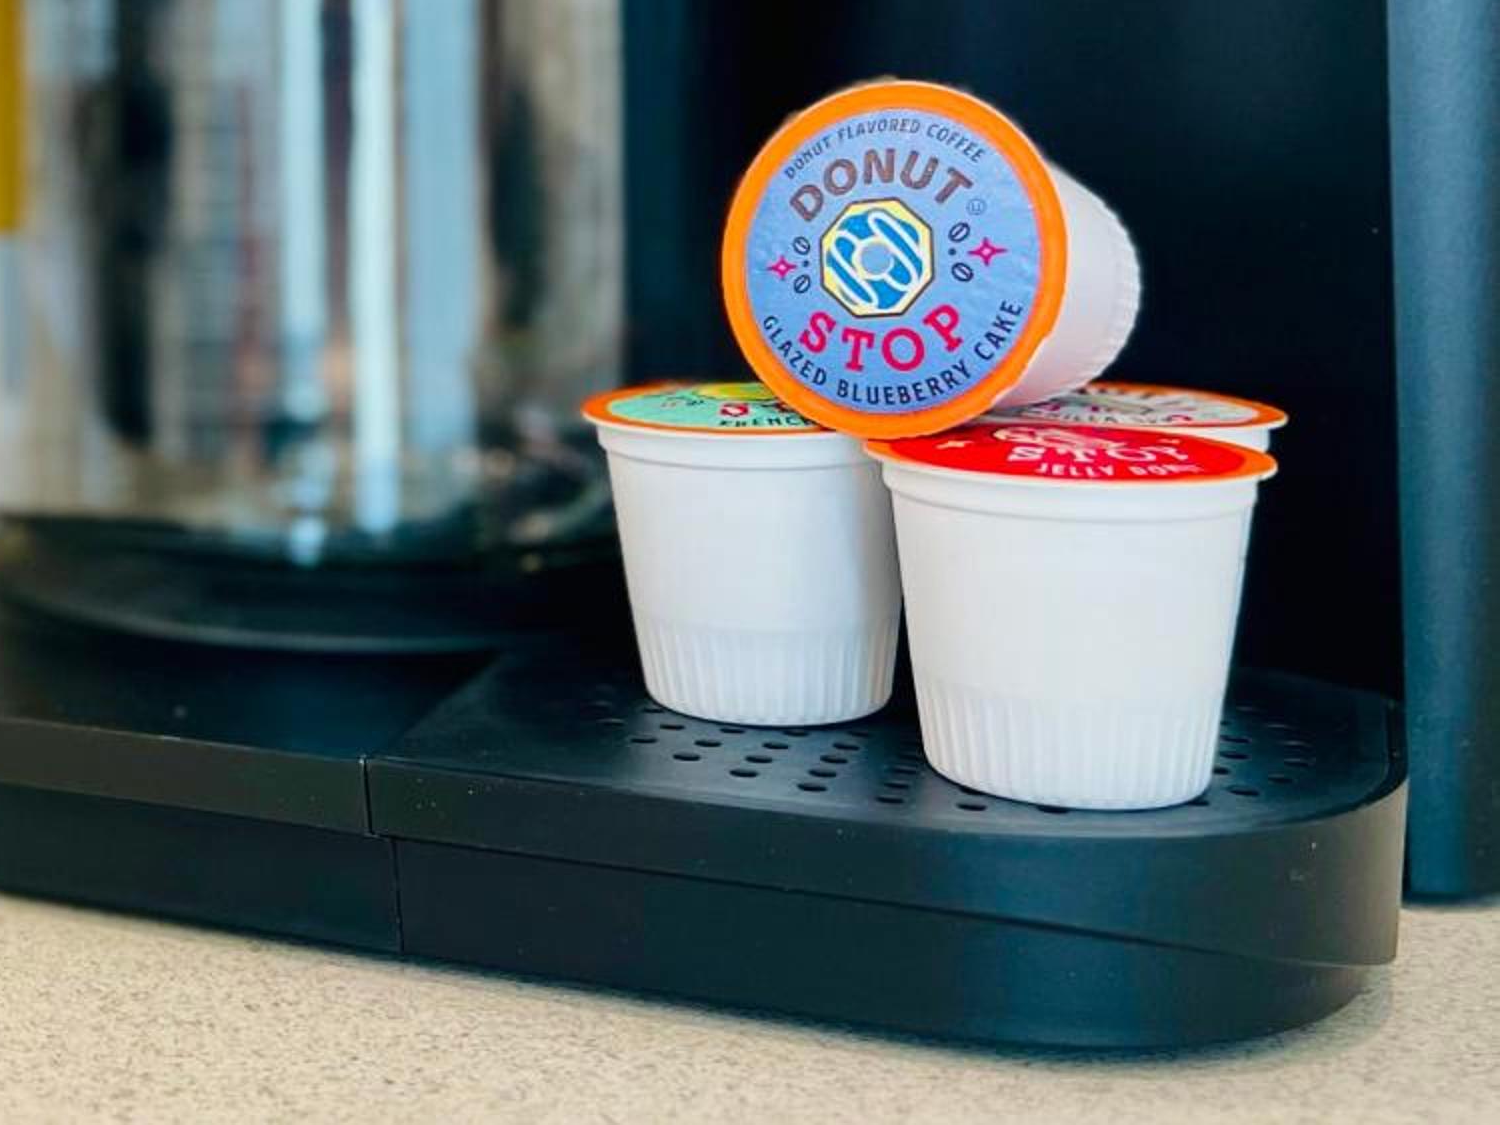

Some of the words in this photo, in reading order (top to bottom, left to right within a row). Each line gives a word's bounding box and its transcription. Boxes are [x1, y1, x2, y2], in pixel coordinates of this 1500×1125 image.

[784, 136, 831, 179] DONUT
[837, 118, 921, 143] FLAVORED
[926, 124, 987, 164] COFFEE
[789, 147, 974, 222] DONUT
[762, 315, 827, 386] GLAZED
[836, 360, 973, 406] BLUEBERRY
[974, 300, 1024, 361] CAKE
[799, 304, 963, 372] STOP
[1035, 462, 1115, 477] JELLY
